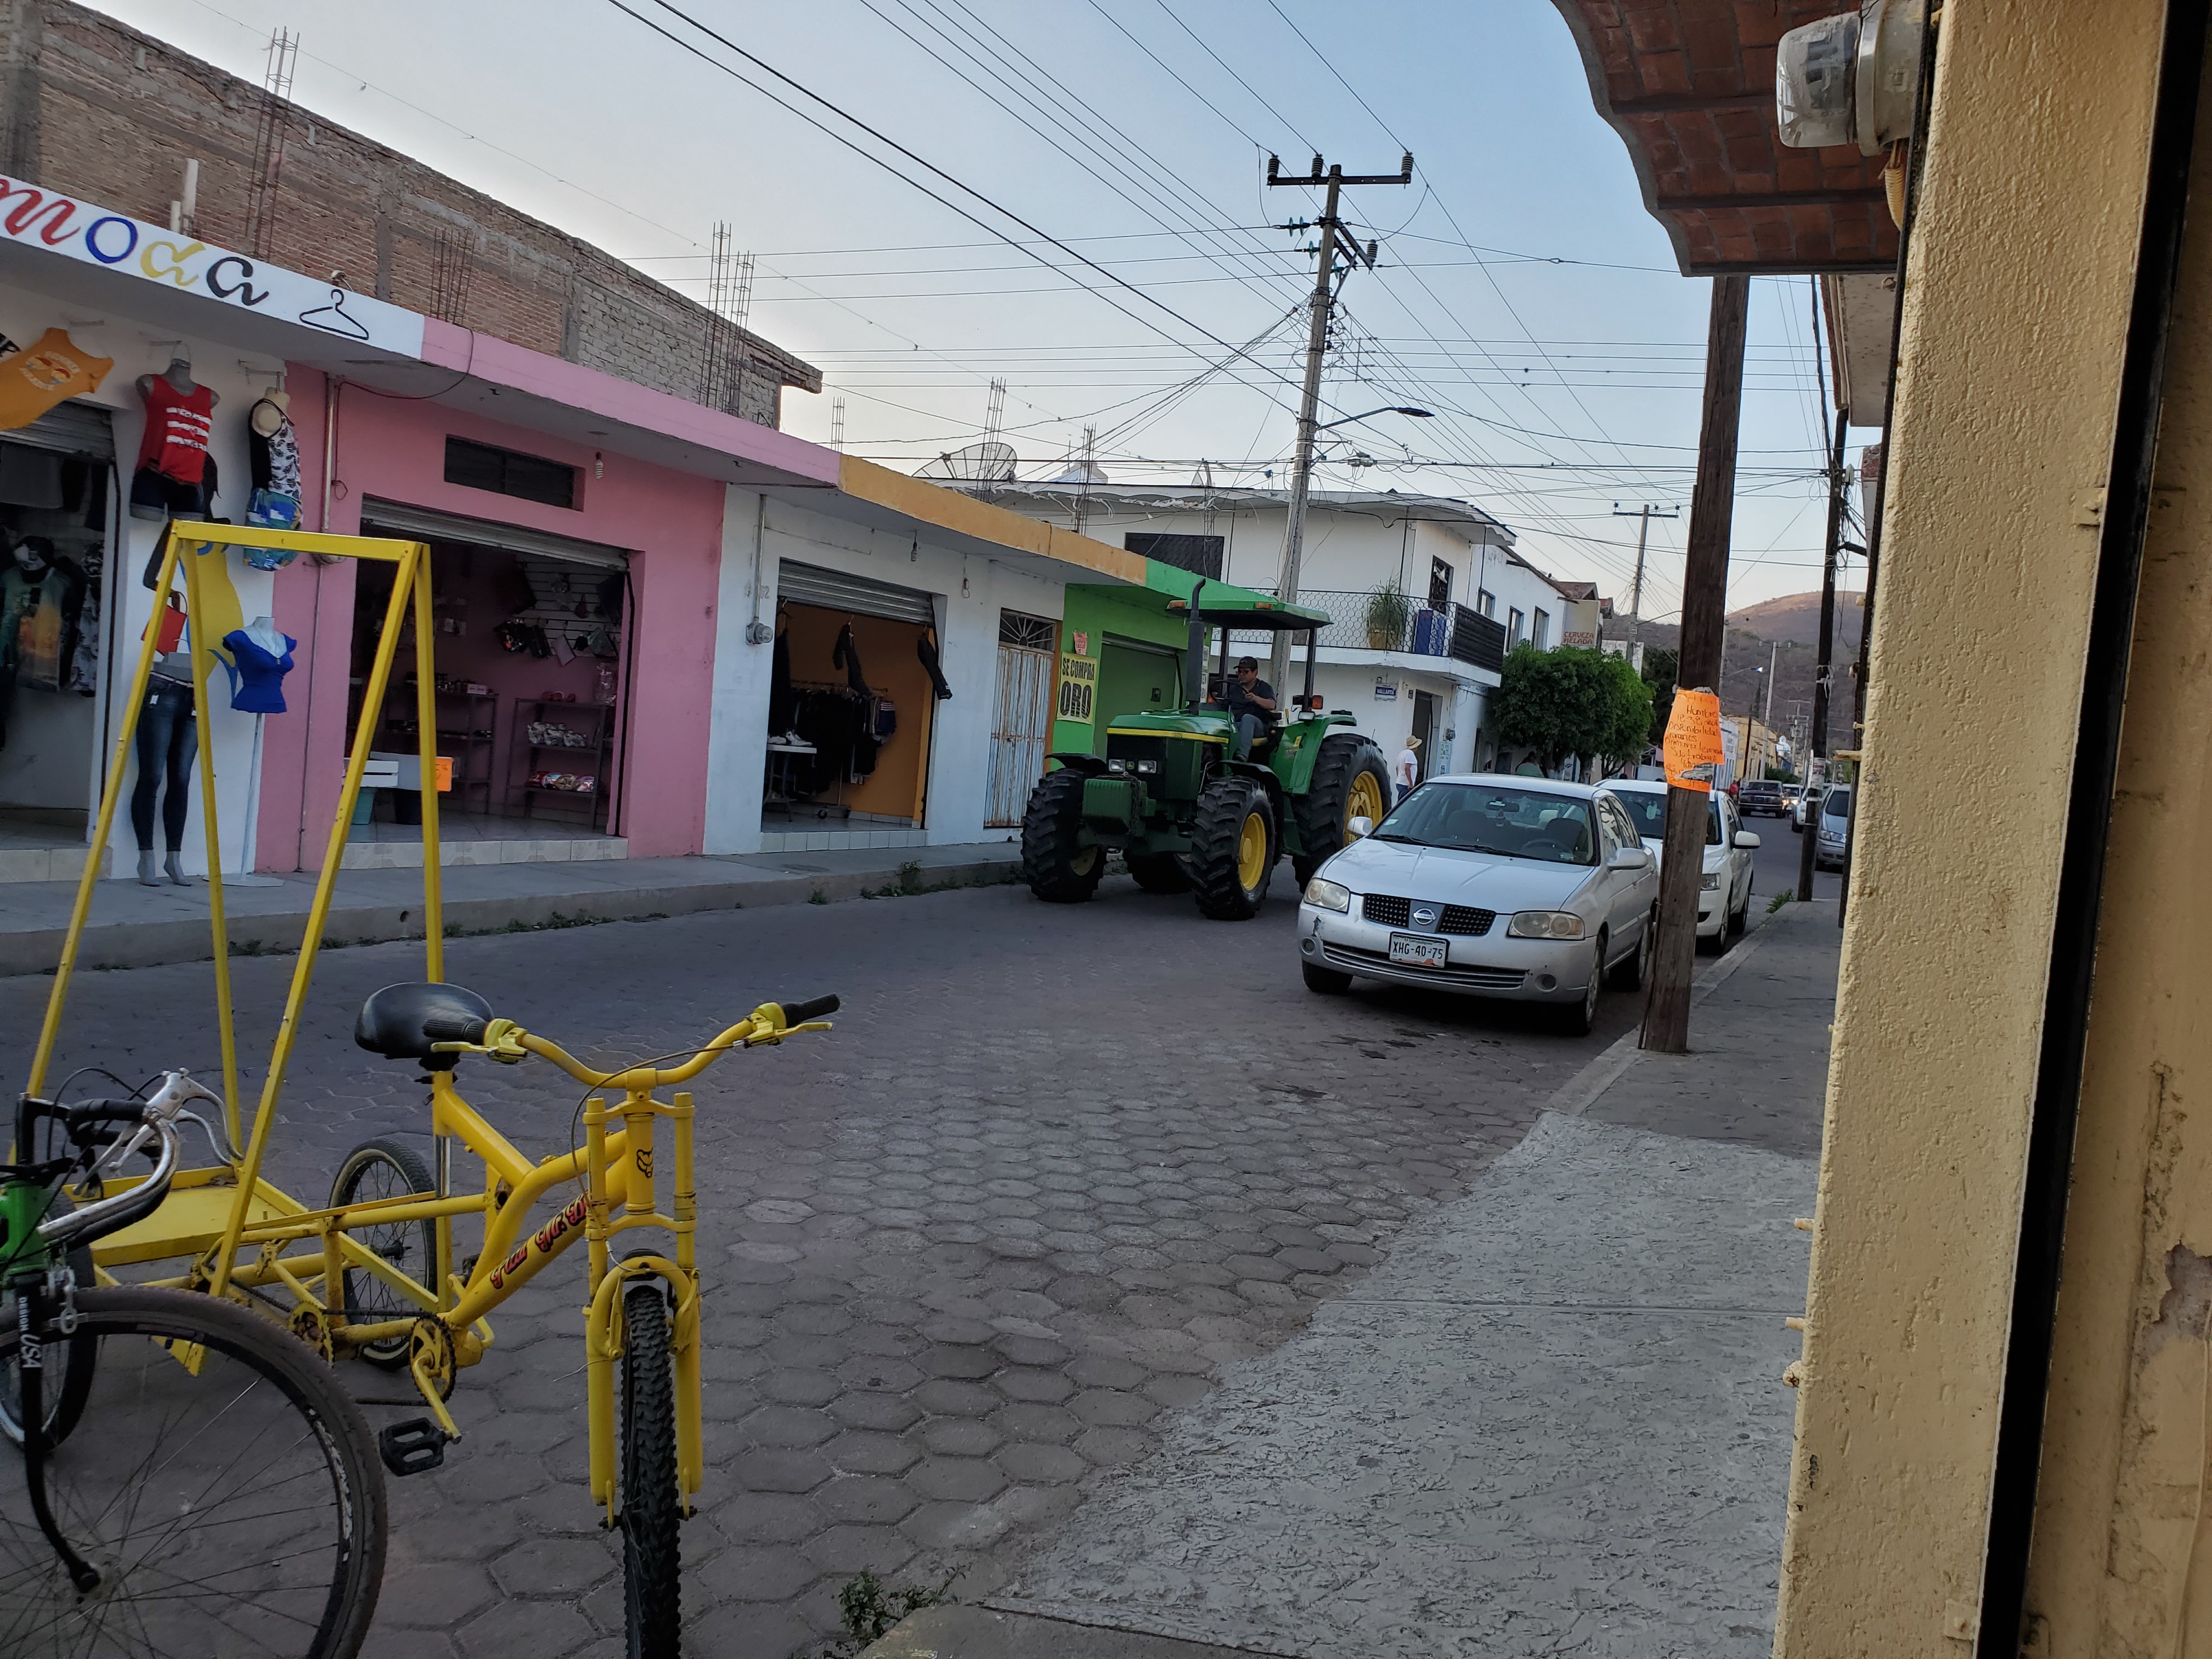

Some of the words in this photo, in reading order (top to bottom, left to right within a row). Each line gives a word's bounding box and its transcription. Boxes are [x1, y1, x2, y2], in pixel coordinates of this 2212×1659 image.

[1062, 658, 1070, 676] SE
[1070, 659, 1095, 680] COMPRA
[1060, 681, 1092, 719] ORO
[20, 1334, 42, 1368] USA
